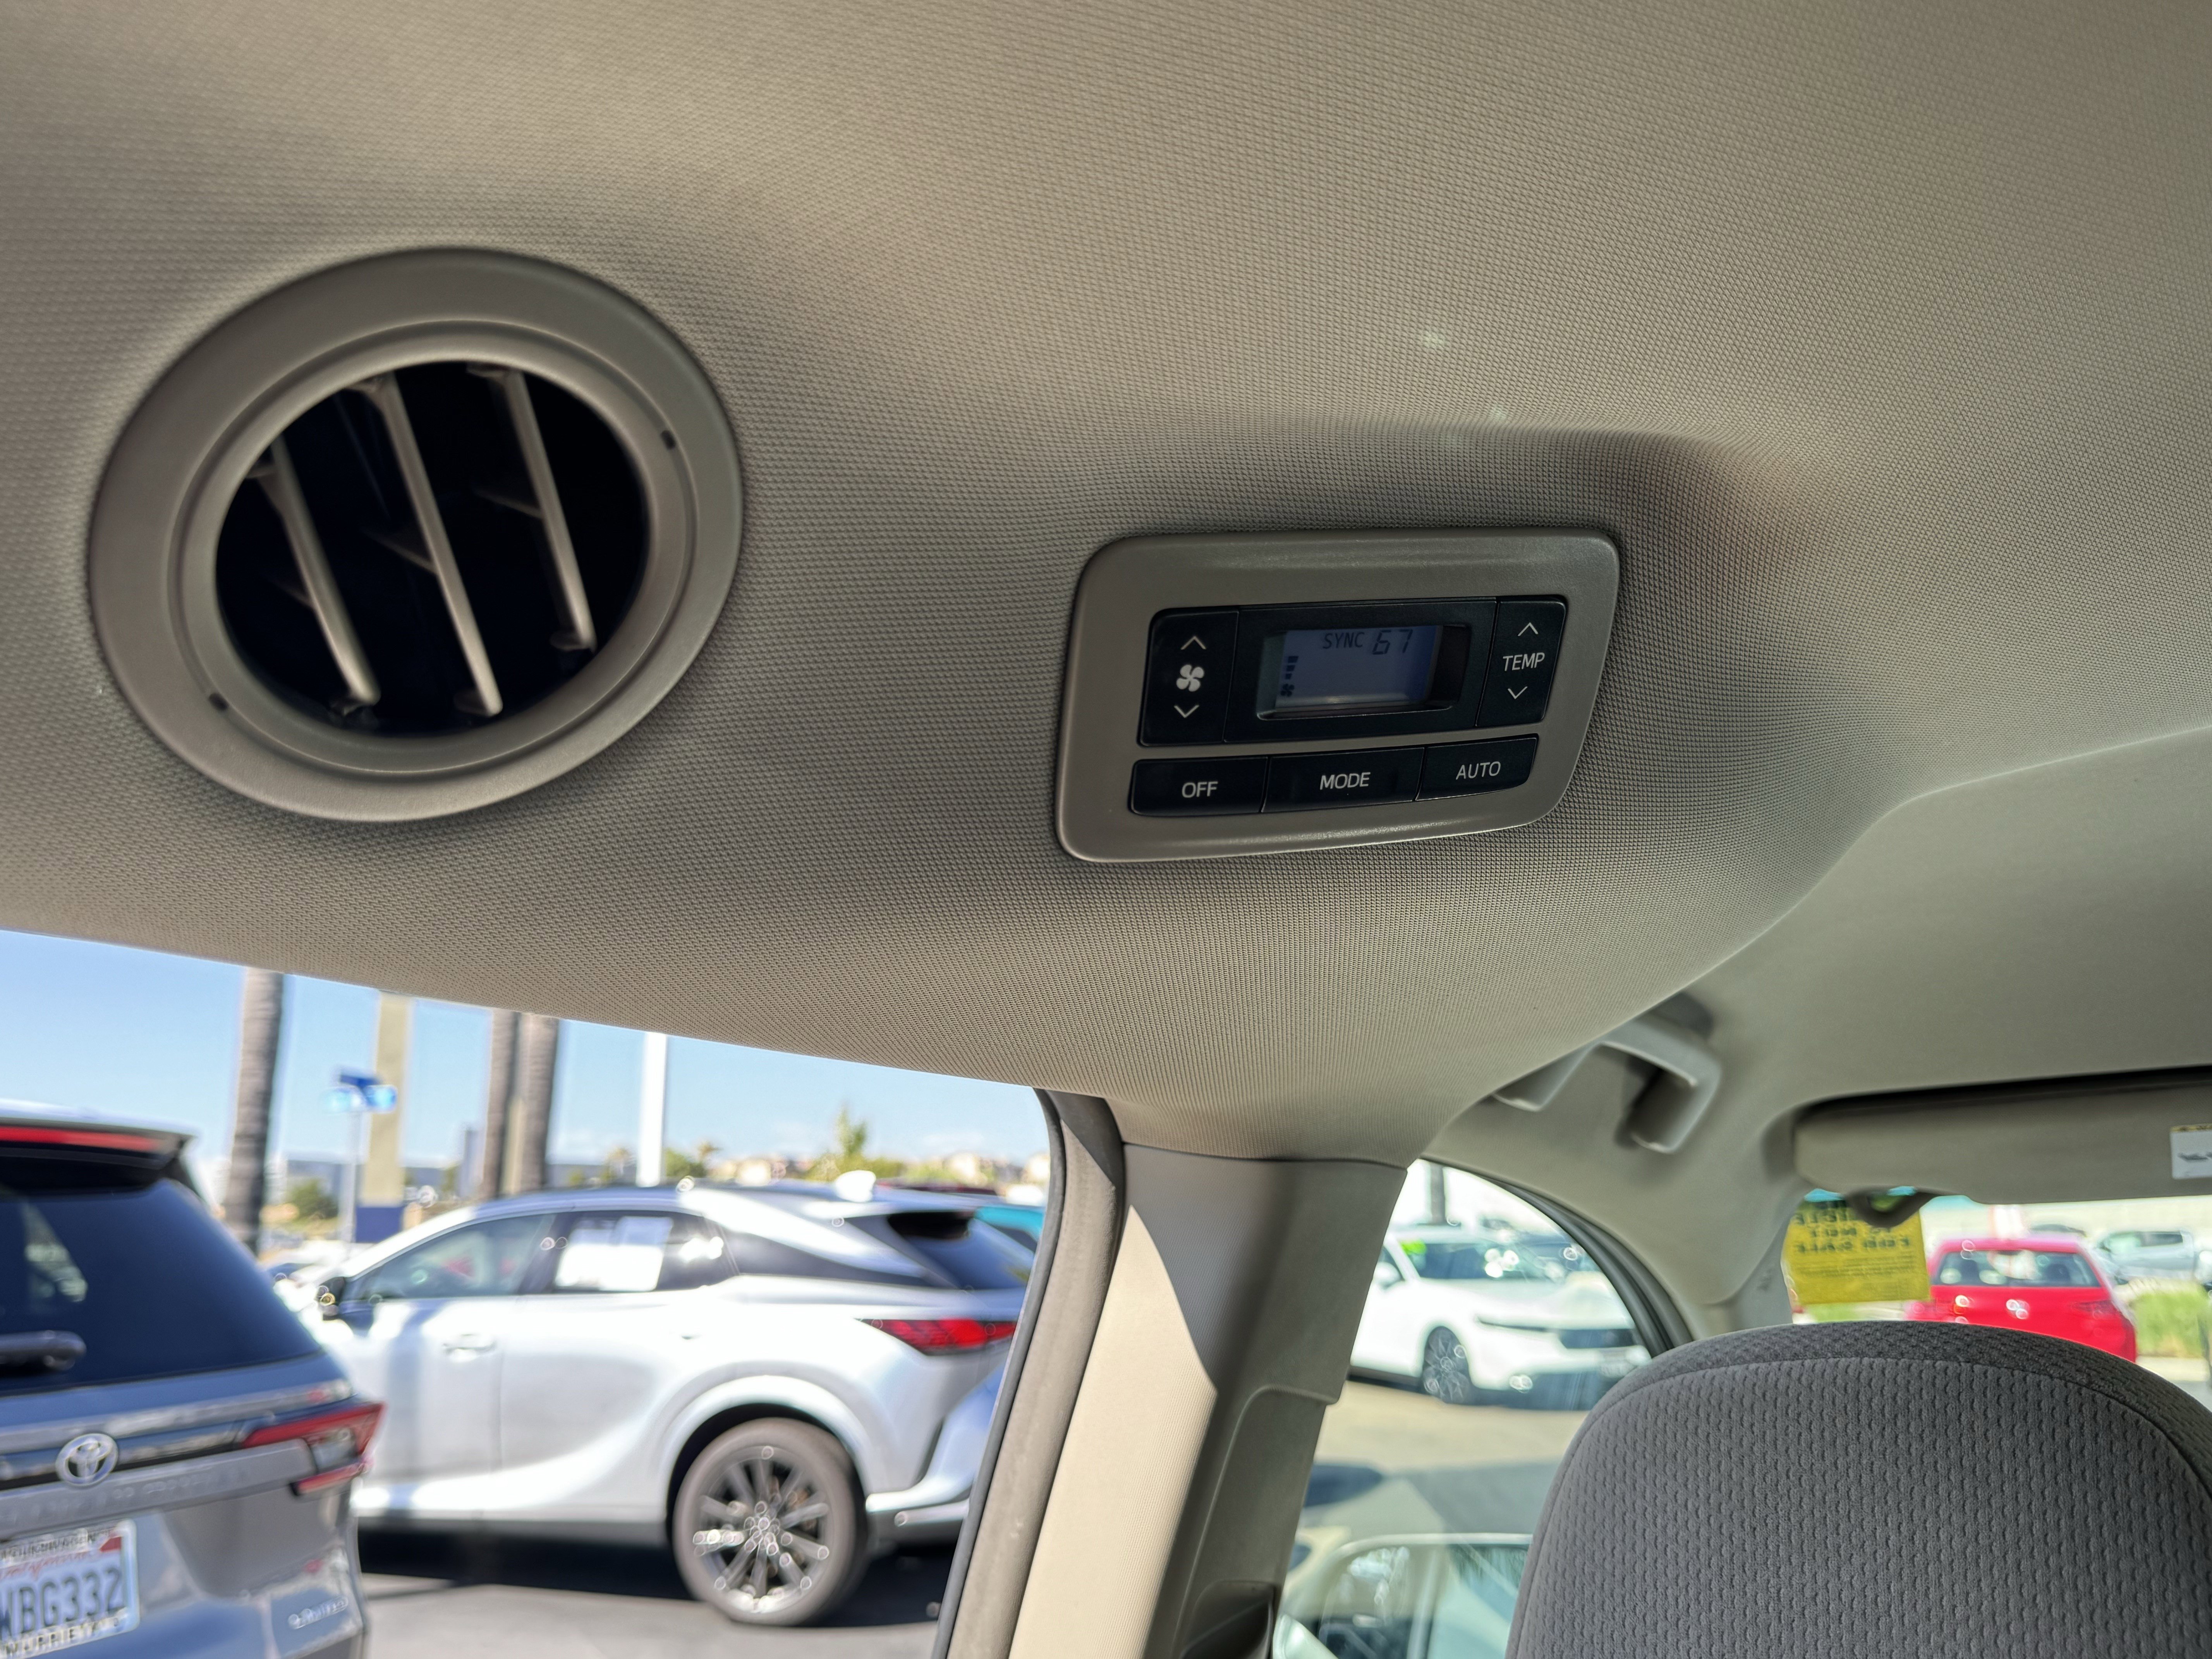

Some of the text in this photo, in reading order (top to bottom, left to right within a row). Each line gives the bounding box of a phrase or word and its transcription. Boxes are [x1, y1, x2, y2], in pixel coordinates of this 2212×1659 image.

[1322, 629, 1413, 655] SYNC 67
[1503, 652, 1545, 672] TEMP
[1455, 761, 1502, 780] AUTO
[1182, 781, 1218, 798] OFF
[1319, 771, 1371, 790] MODE
